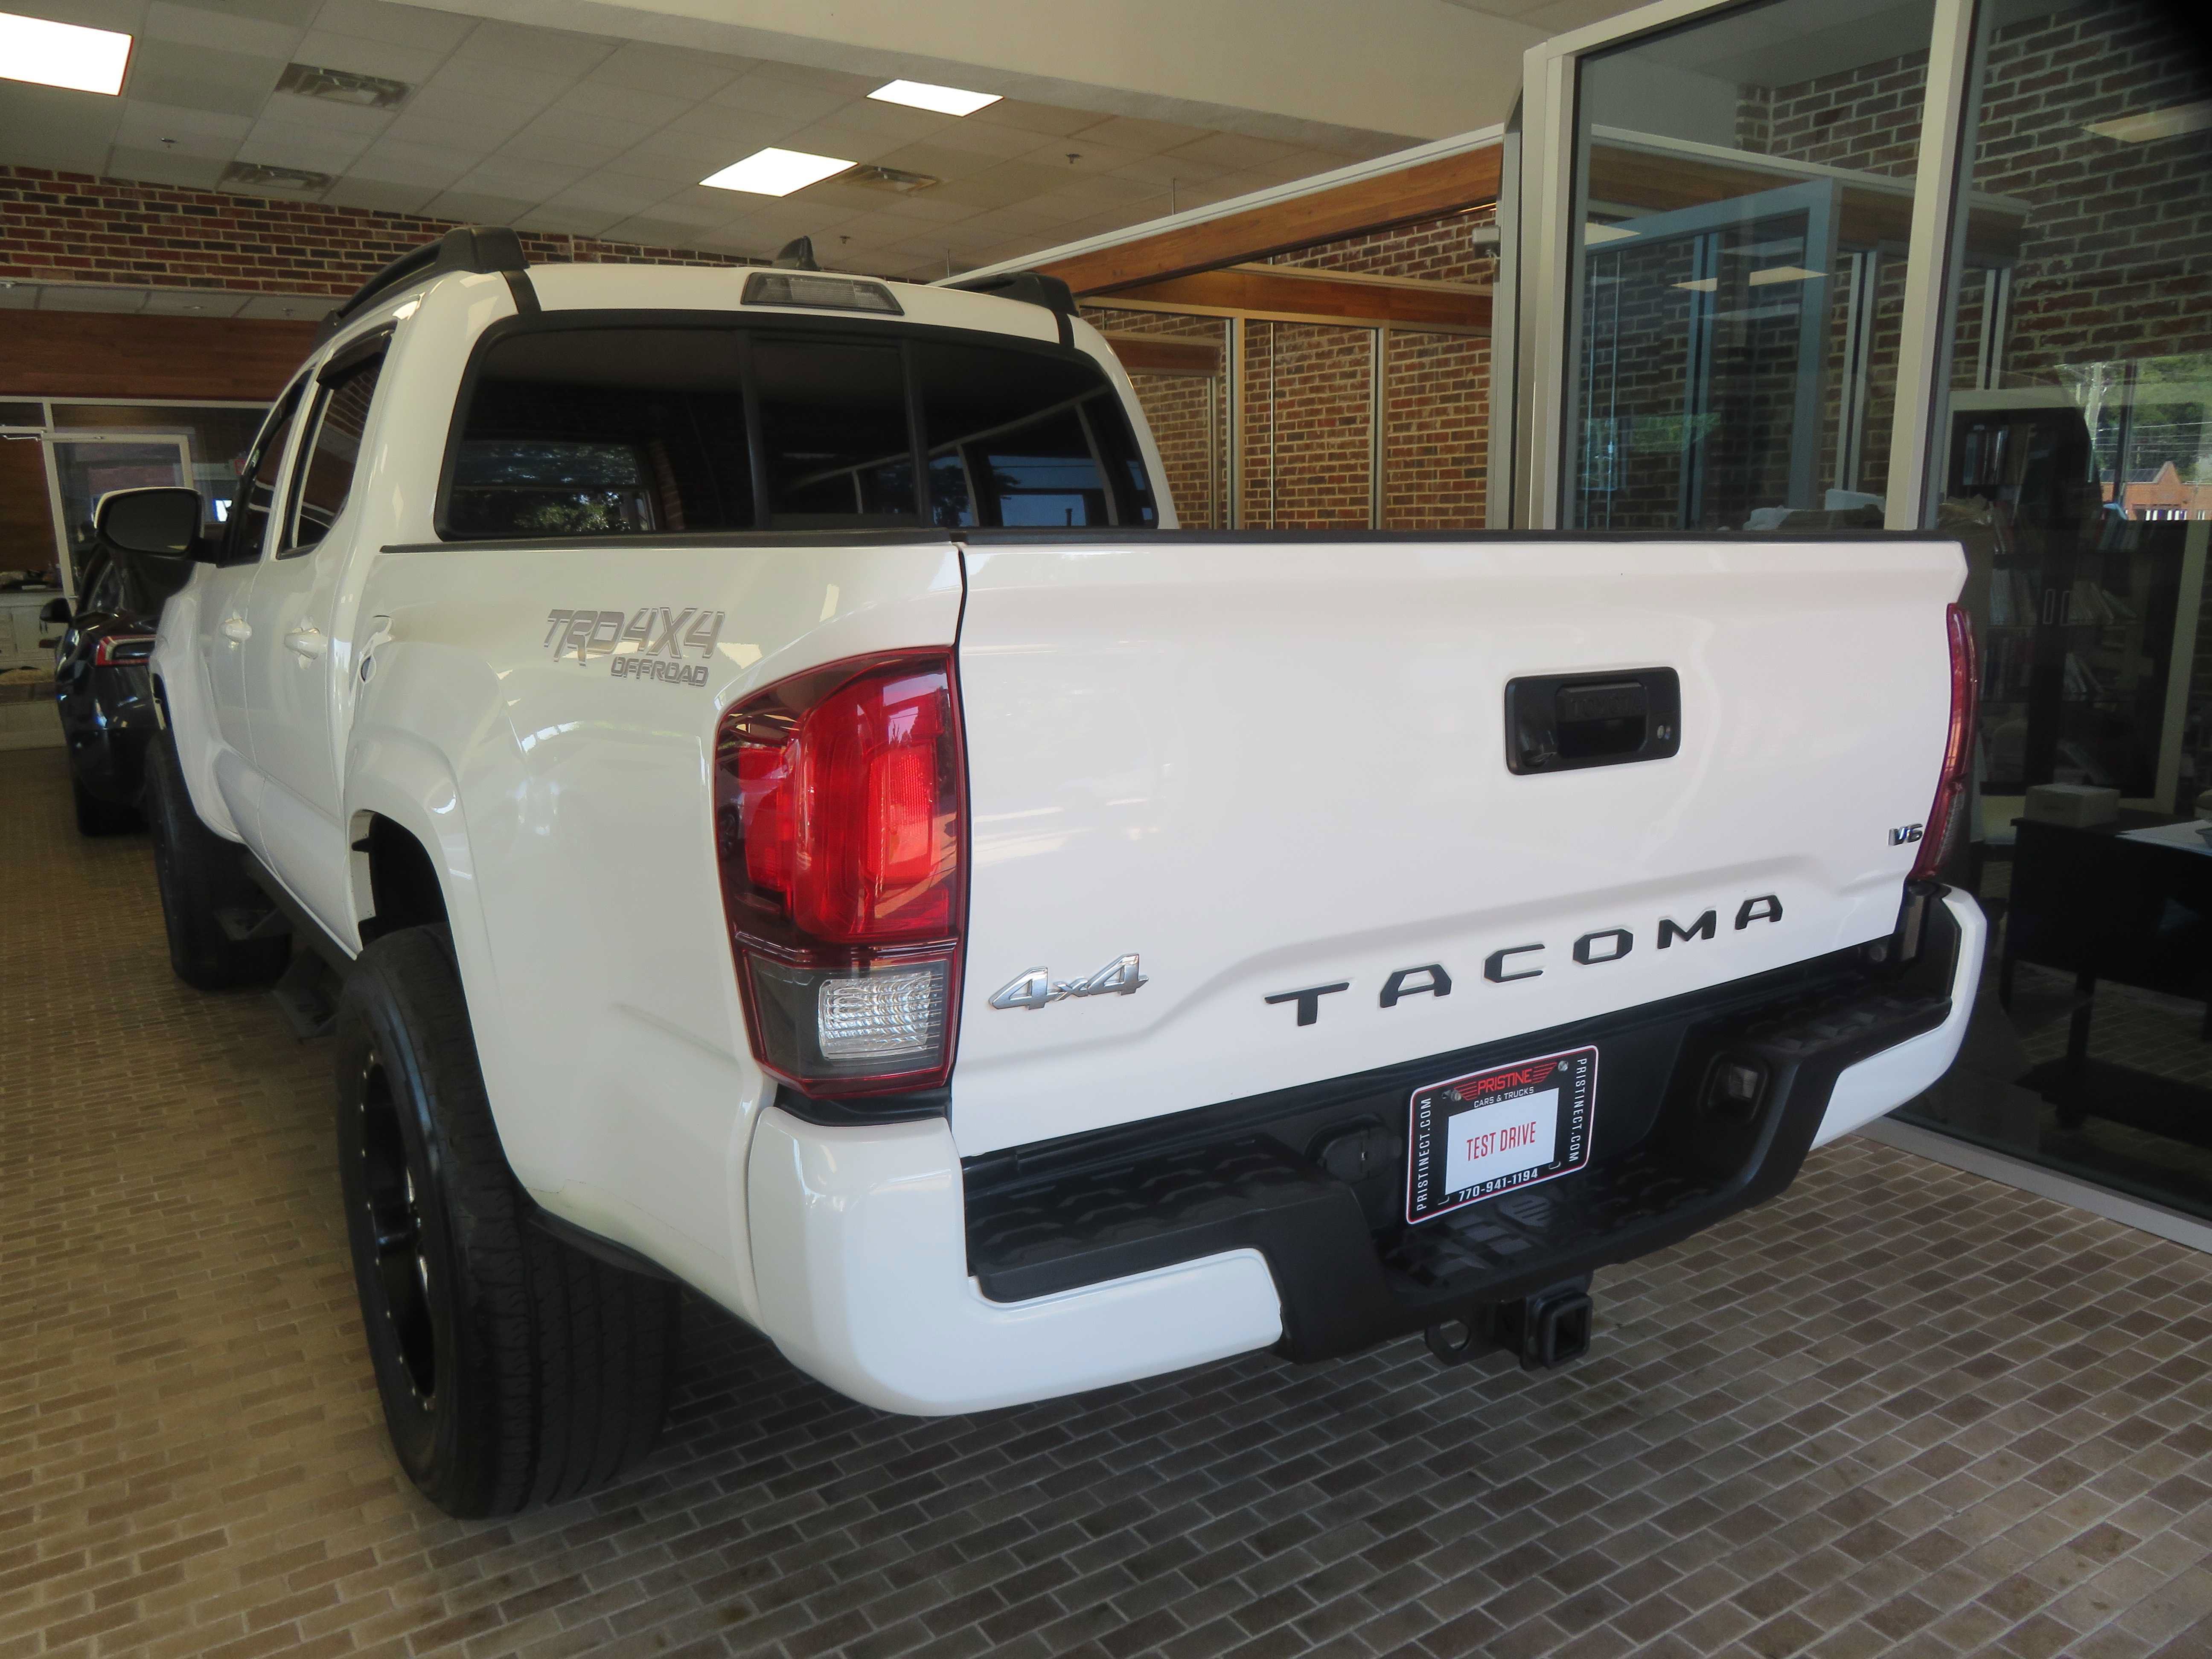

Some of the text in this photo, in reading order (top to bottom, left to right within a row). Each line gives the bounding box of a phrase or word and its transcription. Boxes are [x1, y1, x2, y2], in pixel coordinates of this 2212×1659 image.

[611, 656, 709, 687] OFFROAD
[1888, 824, 1923, 846] V6
[1264, 894, 1783, 1026] TACOMA
[1474, 1097, 1494, 1108] CARS
[1504, 1086, 1534, 1100] TRUCKS
[1478, 1068, 1533, 1095] PRISTINE
[1569, 1058, 1587, 1162] PRISTINECT.COM
[1416, 1097, 1431, 1211] PRISTINECT.COM
[1467, 1121, 1537, 1161] TEST DRIVE
[1458, 1168, 1538, 1202] 770-941-1194
